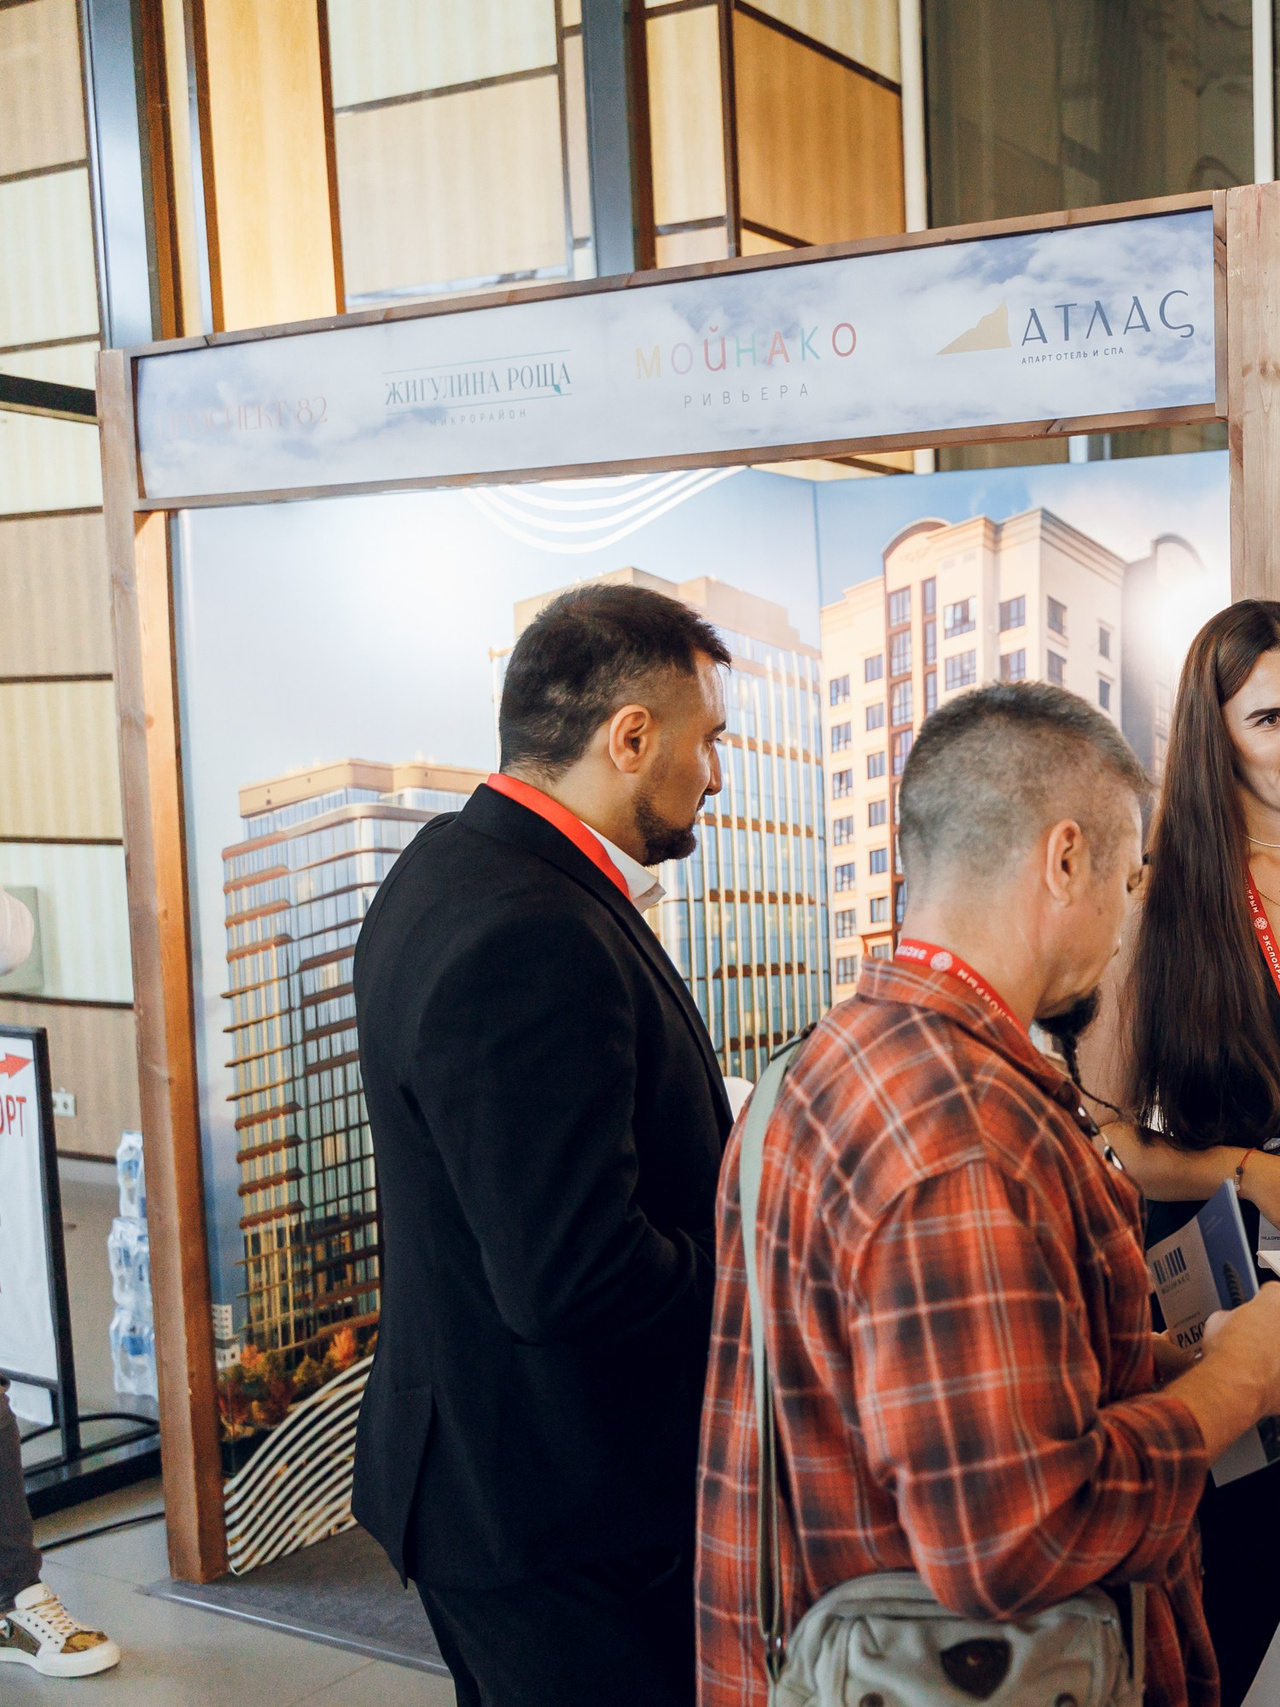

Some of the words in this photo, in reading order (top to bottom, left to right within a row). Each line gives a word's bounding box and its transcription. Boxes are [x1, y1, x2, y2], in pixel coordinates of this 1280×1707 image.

[635, 322, 857, 379] МОЙНАКО
[1104, 347, 1124, 356] СПА
[385, 370, 500, 405] ЖИГУЛИНА
[507, 361, 571, 393] РОЩА
[684, 383, 808, 408] РИВЬЕРА
[297, 396, 328, 425] 82
